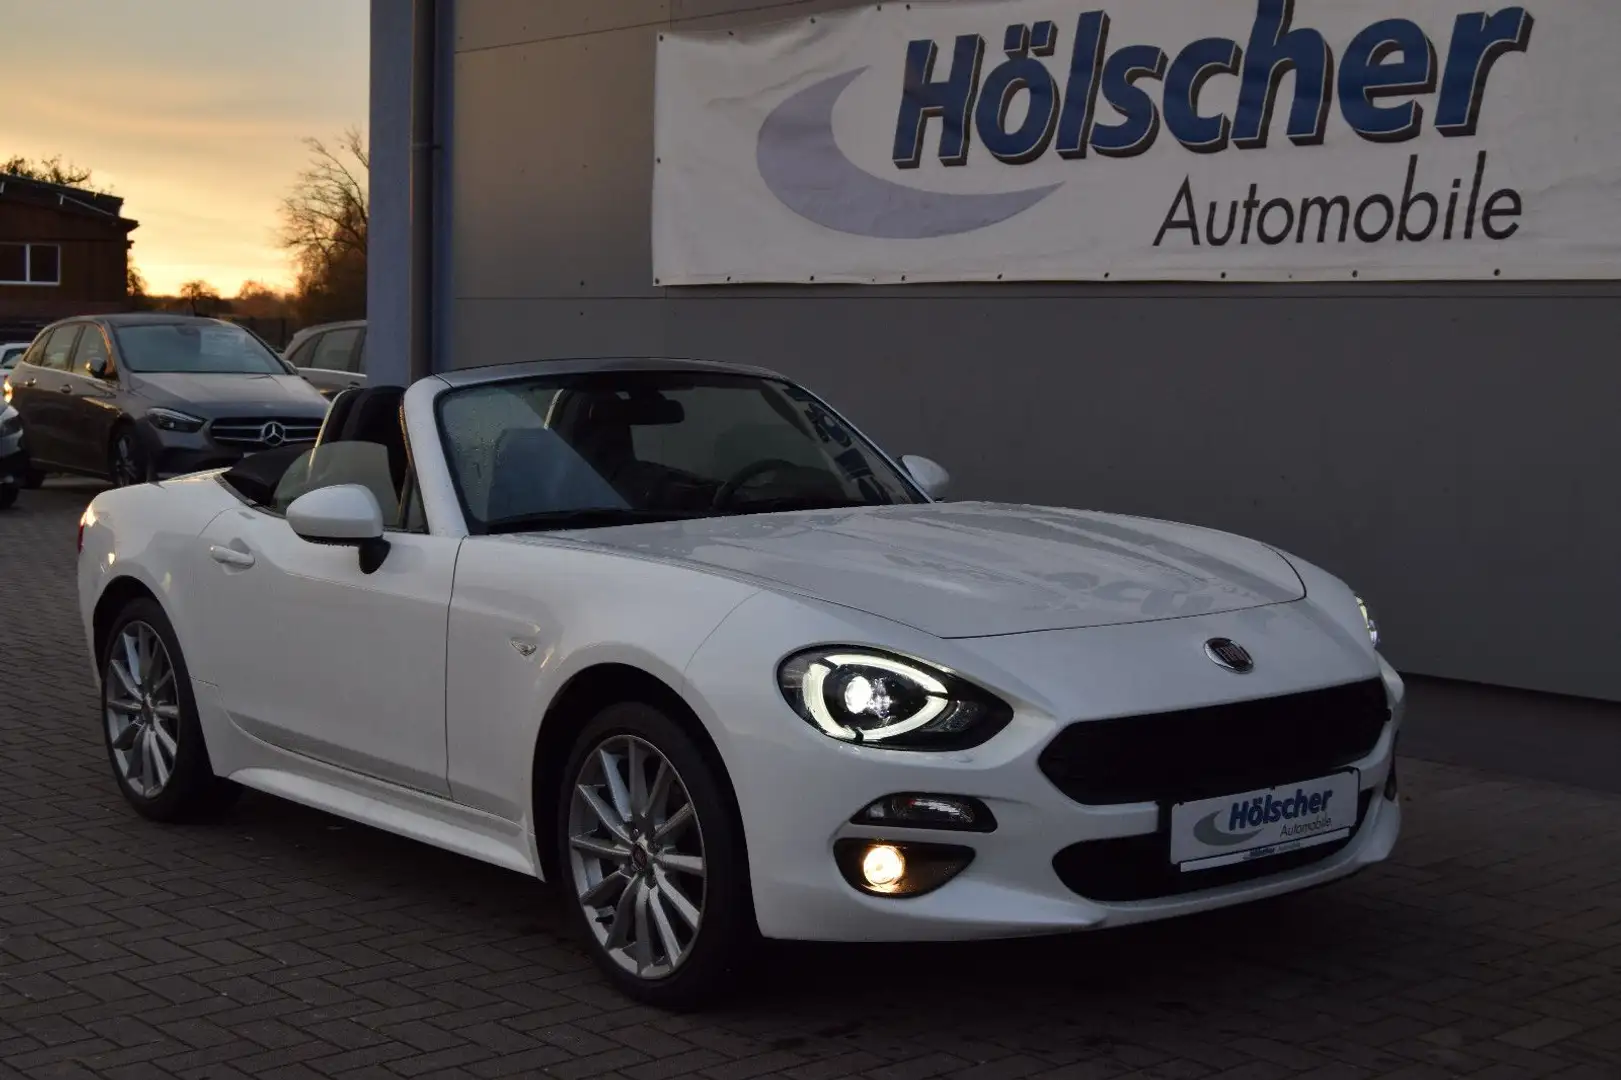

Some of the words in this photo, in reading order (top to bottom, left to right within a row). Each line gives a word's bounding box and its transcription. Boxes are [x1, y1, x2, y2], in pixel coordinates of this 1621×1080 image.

[892, 0, 1534, 169] Hölscher
[1152, 151, 1523, 246] Automobile
[1229, 789, 1333, 831] Hölscher
[1280, 816, 1332, 837] Automobile
